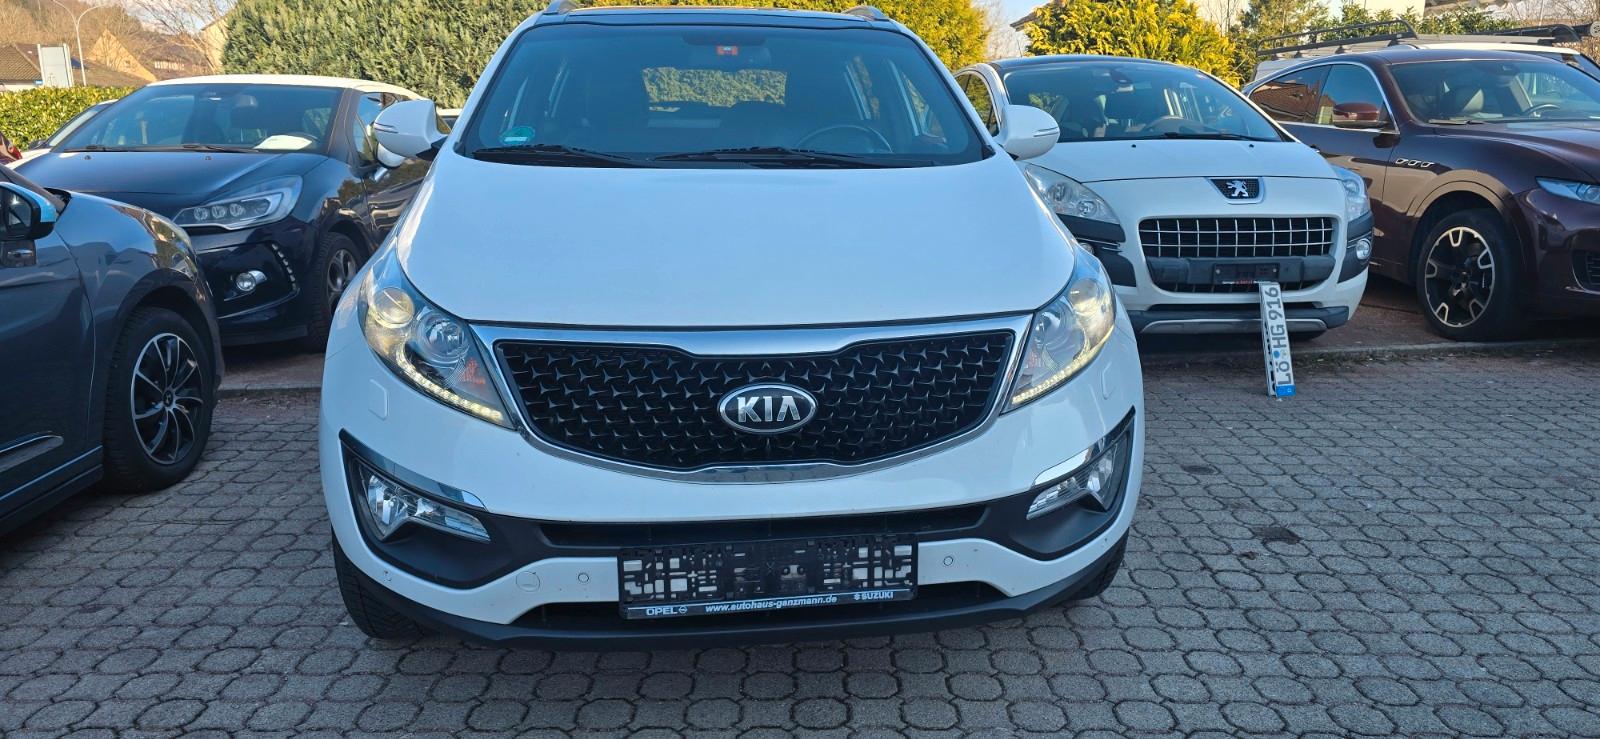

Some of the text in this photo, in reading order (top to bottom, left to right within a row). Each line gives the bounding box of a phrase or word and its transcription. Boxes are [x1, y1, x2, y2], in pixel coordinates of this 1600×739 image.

[1264, 287, 1284, 321] 916
[1270, 324, 1287, 349] HG
[1275, 361, 1292, 385] LÖ
[737, 395, 800, 422] KIA
[646, 591, 894, 616] OPEL www.autohaus-ganzmann.de SUZUKI
